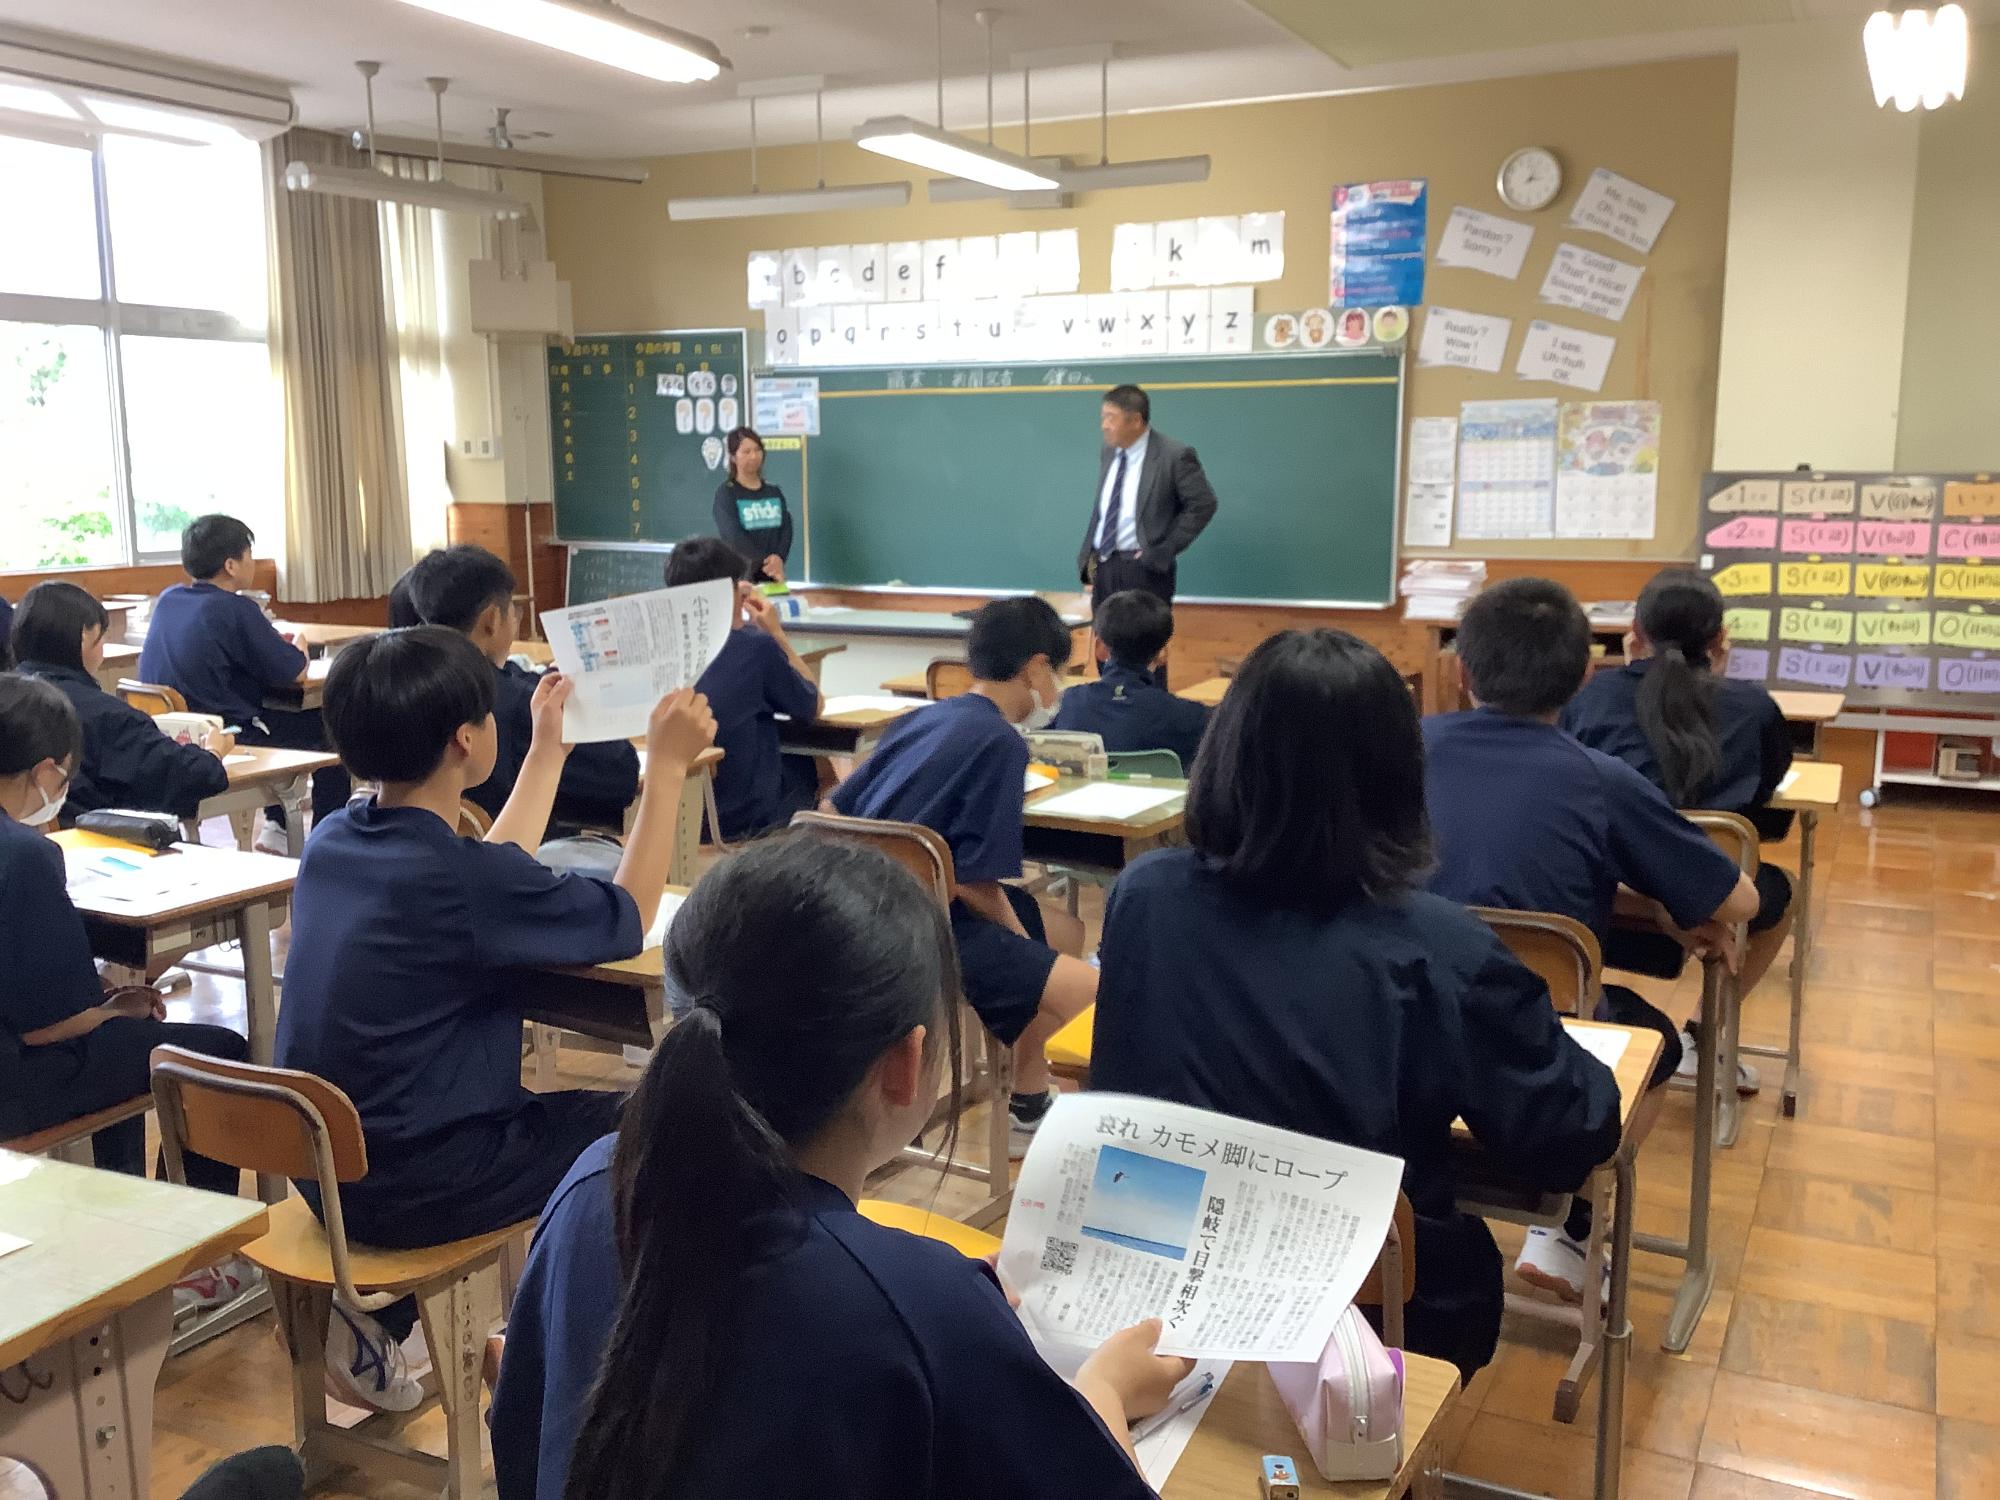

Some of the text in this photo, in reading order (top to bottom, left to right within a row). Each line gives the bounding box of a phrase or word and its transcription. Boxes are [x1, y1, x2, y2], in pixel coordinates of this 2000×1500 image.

[862, 259, 875, 282] d
[898, 263, 911, 280] e
[935, 255, 946, 279] f
[1168, 237, 1183, 262] k
[1251, 237, 1271, 255] m
[776, 312, 1239, 346] o p q r s t u v w x y z
[627, 406, 637, 420] 2
[632, 522, 640, 535] 7
[1149, 1124, 1349, 1190] カモメ脚にロープ
[1168, 1195, 1225, 1329] 隠岐で目撃相次ぐ
